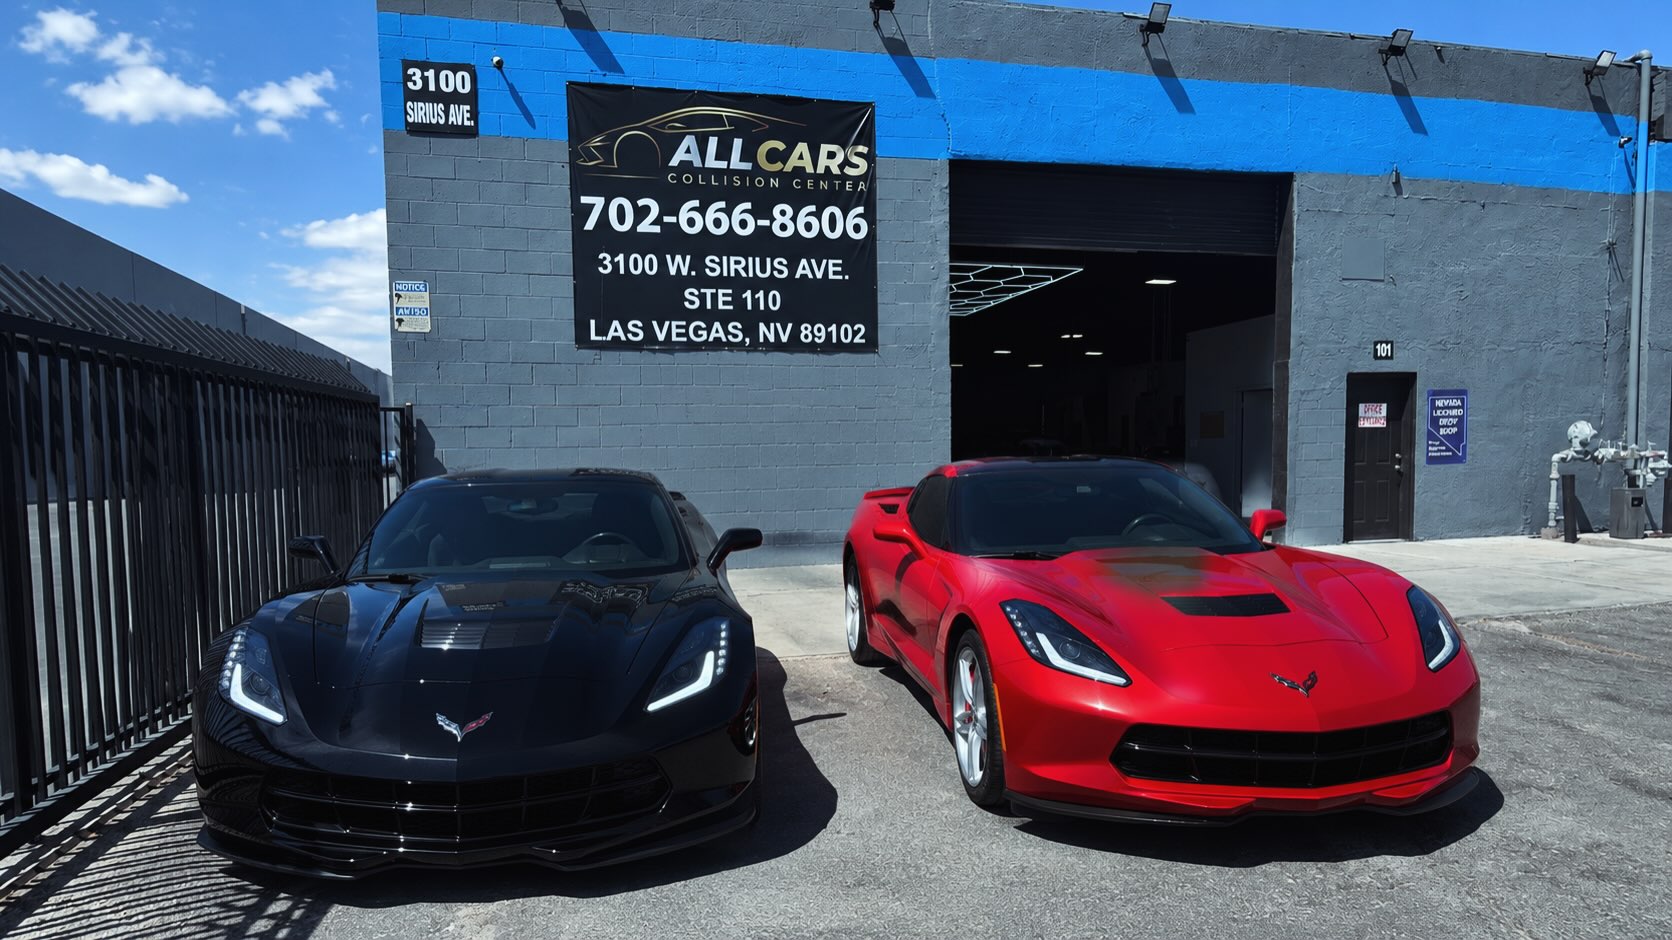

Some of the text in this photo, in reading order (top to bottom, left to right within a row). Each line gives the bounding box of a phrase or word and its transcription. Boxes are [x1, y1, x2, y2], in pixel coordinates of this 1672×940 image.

[407, 67, 471, 94] 3100
[406, 101, 474, 126] SIRIUS AVE.
[668, 134, 869, 176] ALL CARS
[667, 172, 779, 189] COLLISION
[580, 195, 869, 240] 702-666-8606
[597, 252, 849, 280] 3100 W. SIRIUS AVE.
[683, 287, 781, 311] STE 110
[589, 319, 866, 347] LAS VEGAS, NV 89102
[1375, 343, 1392, 357] 101
